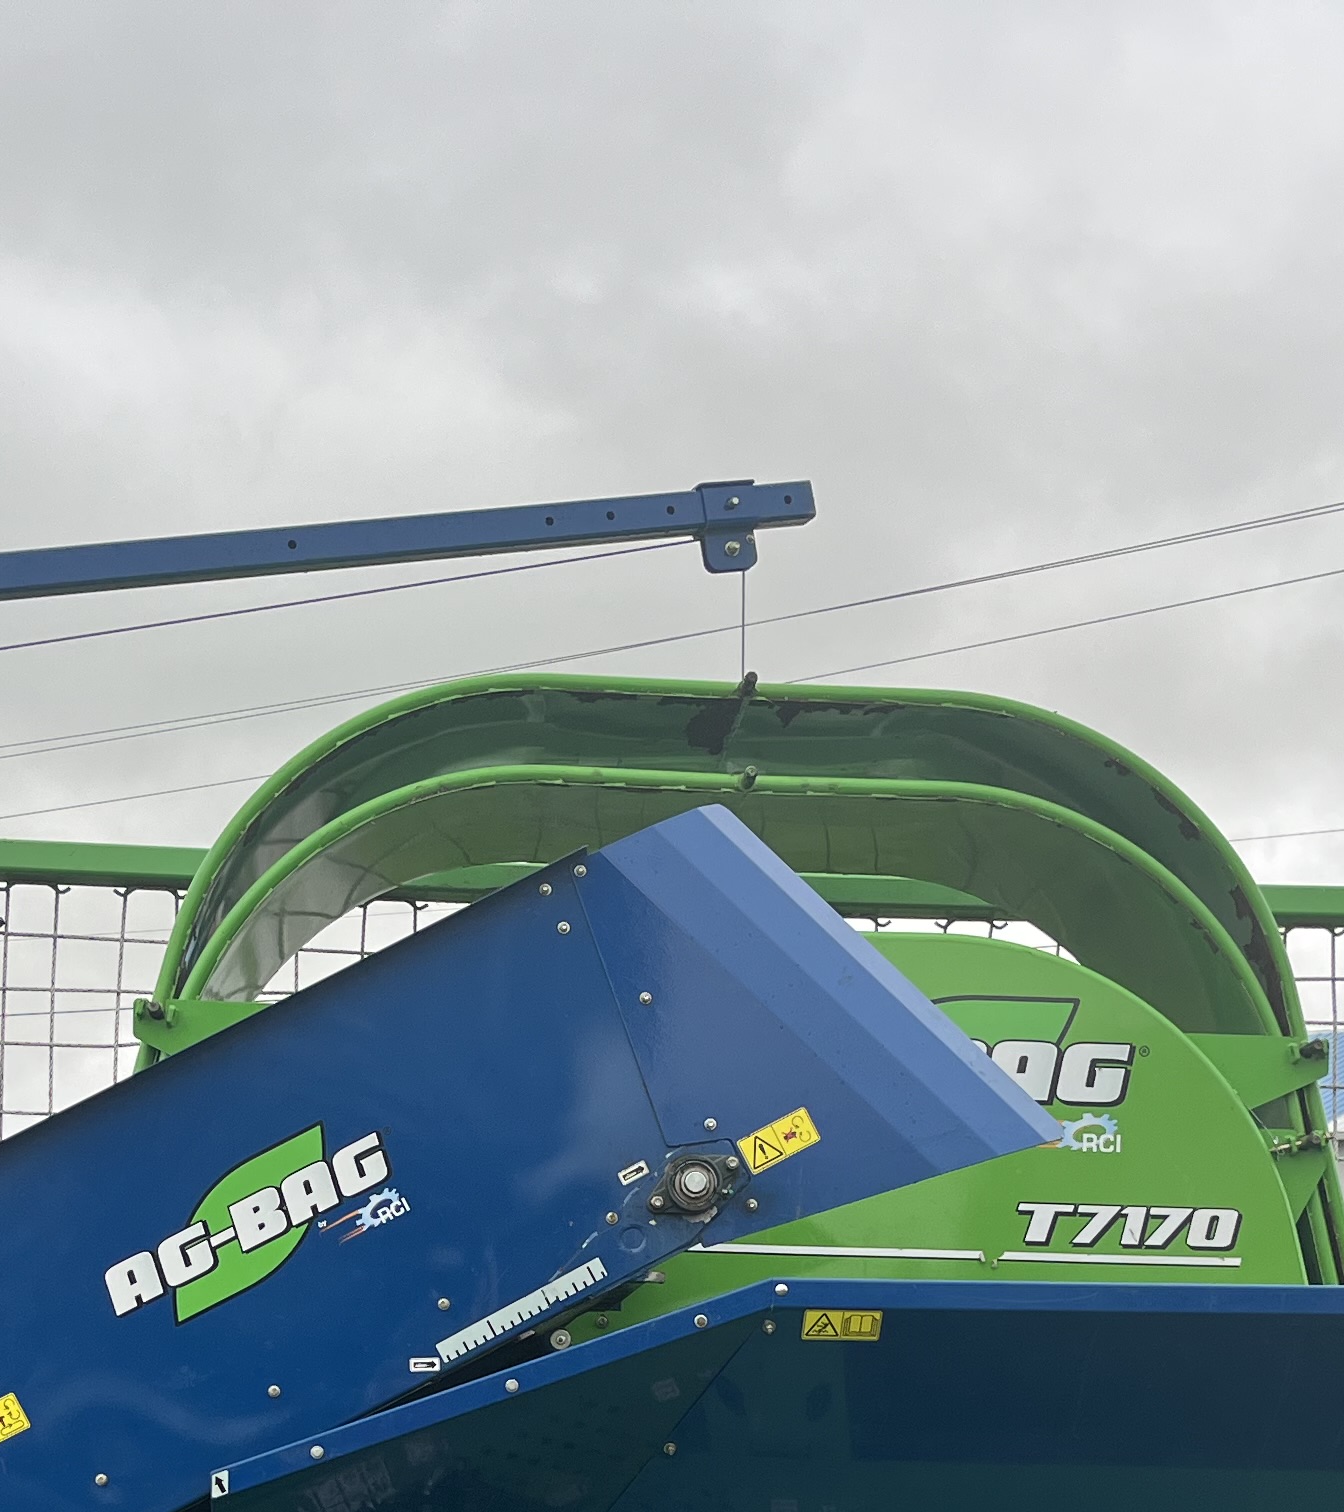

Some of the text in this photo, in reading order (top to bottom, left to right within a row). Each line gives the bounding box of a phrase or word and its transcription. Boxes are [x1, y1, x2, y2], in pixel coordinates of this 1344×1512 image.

[970, 1040, 1135, 1106] AG
[1082, 1133, 1122, 1153] RCI
[104, 1131, 392, 1318] AG-BAG
[376, 1197, 411, 1224] RCI
[1015, 1202, 1243, 1251] T7170
